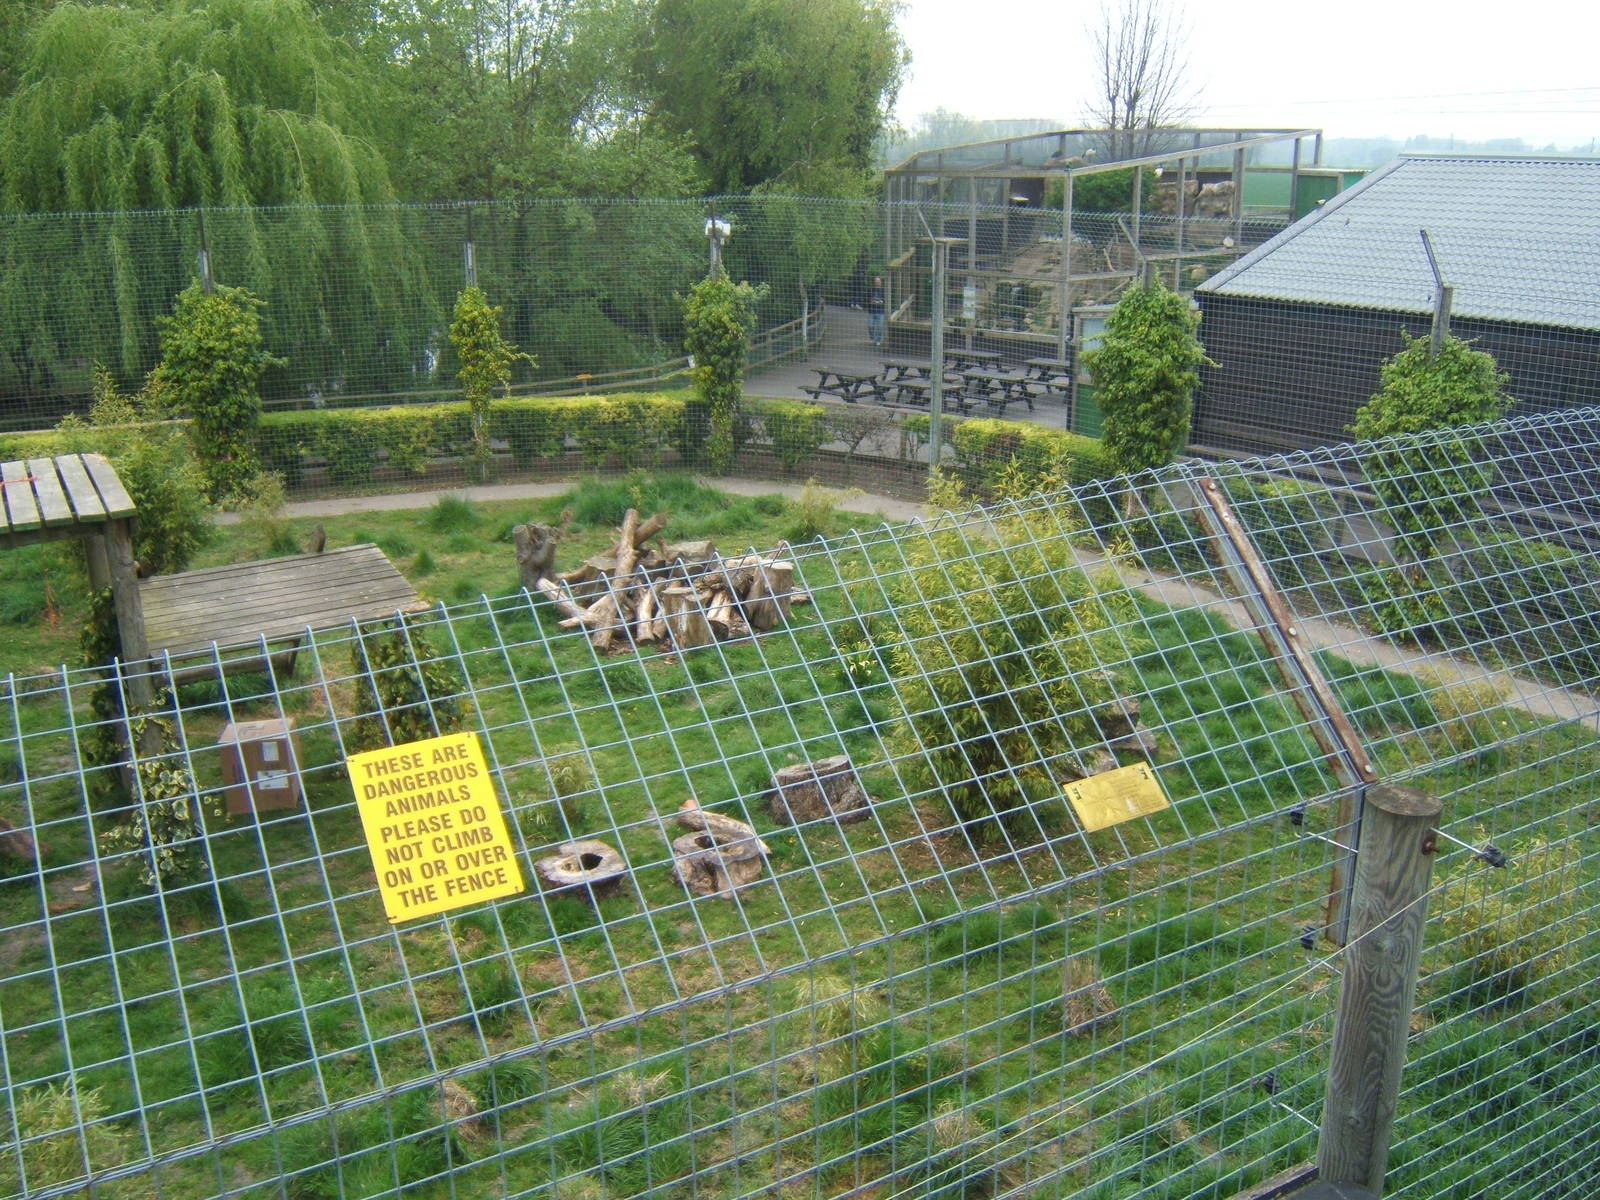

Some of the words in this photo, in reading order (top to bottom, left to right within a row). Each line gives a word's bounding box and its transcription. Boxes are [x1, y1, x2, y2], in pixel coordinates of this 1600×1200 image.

[362, 752, 424, 779] THESE
[432, 744, 469, 764] ARE
[364, 762, 478, 800] DANGEROUS
[385, 785, 471, 817] ANIMALS
[380, 813, 453, 844] PLEASE
[460, 806, 486, 825] DO
[386, 841, 424, 865] NOT
[432, 826, 493, 854] CLIMB
[384, 867, 413, 888] ON
[420, 859, 449, 880] OR
[455, 845, 507, 871] OVER
[398, 884, 438, 907] THE
[444, 868, 507, 897] FENCE
